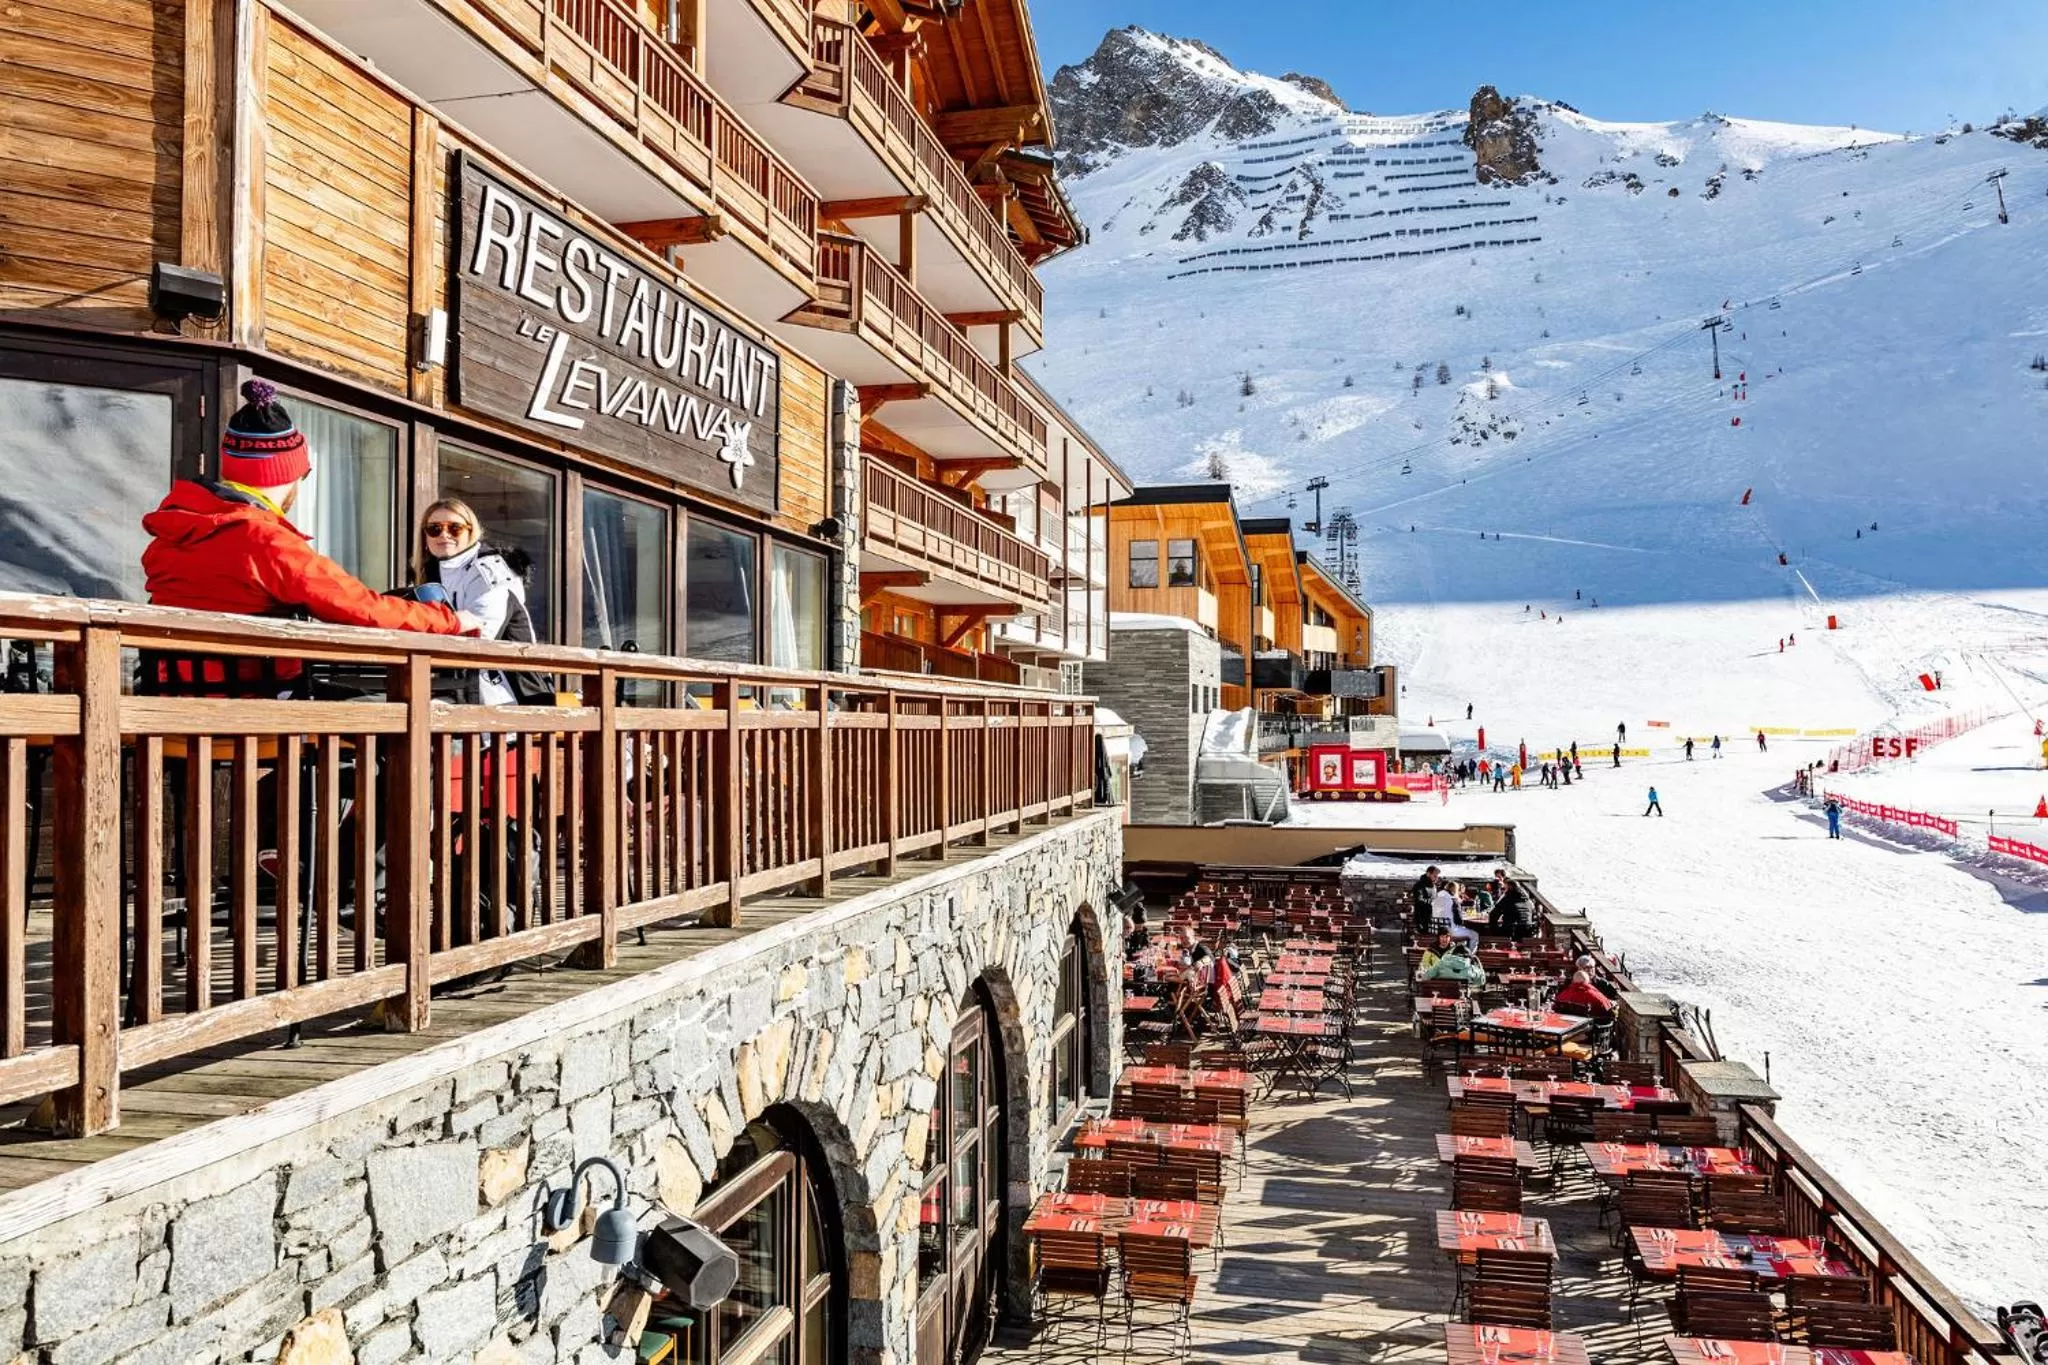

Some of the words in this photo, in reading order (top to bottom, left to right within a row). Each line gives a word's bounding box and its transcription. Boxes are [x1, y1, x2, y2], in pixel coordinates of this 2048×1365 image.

[474, 185, 777, 417] RESTAURANT
[519, 319, 554, 343] LE
[529, 331, 731, 445] LÉVANNA
[1872, 737, 1918, 758] ESF
